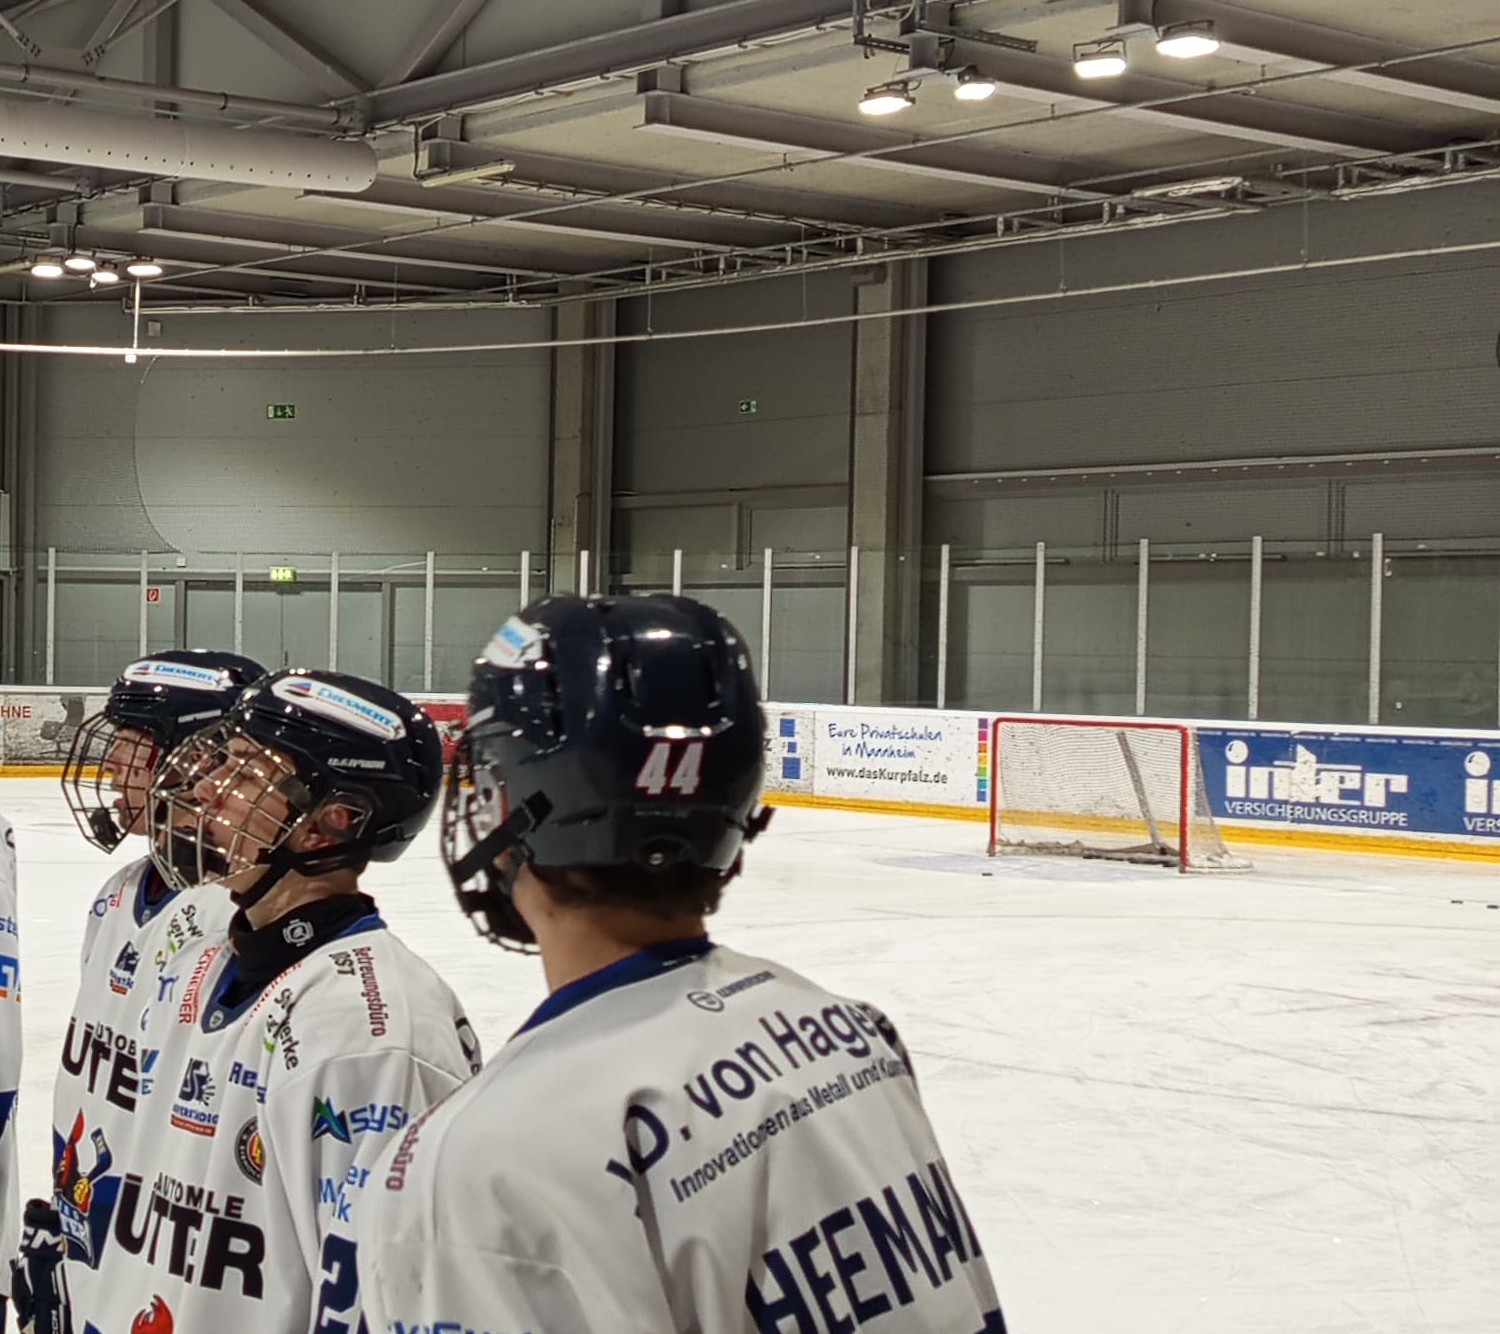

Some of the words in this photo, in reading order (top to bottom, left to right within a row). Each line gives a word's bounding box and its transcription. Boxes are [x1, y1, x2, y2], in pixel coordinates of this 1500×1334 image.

[827, 723, 857, 740] Eure
[860, 723, 943, 743] Privatschulen
[842, 742, 853, 757] in
[854, 741, 917, 760] Mannheim
[635, 741, 704, 796] 44
[826, 765, 949, 785] www.dasKurpfalz.de
[1224, 799, 1410, 828] VERSICHERUNGSGRUPPE
[683, 1037, 784, 1119] von
[669, 1109, 792, 1204] Innovationen
[789, 1097, 815, 1123] aus
[807, 1072, 855, 1110] Metall
